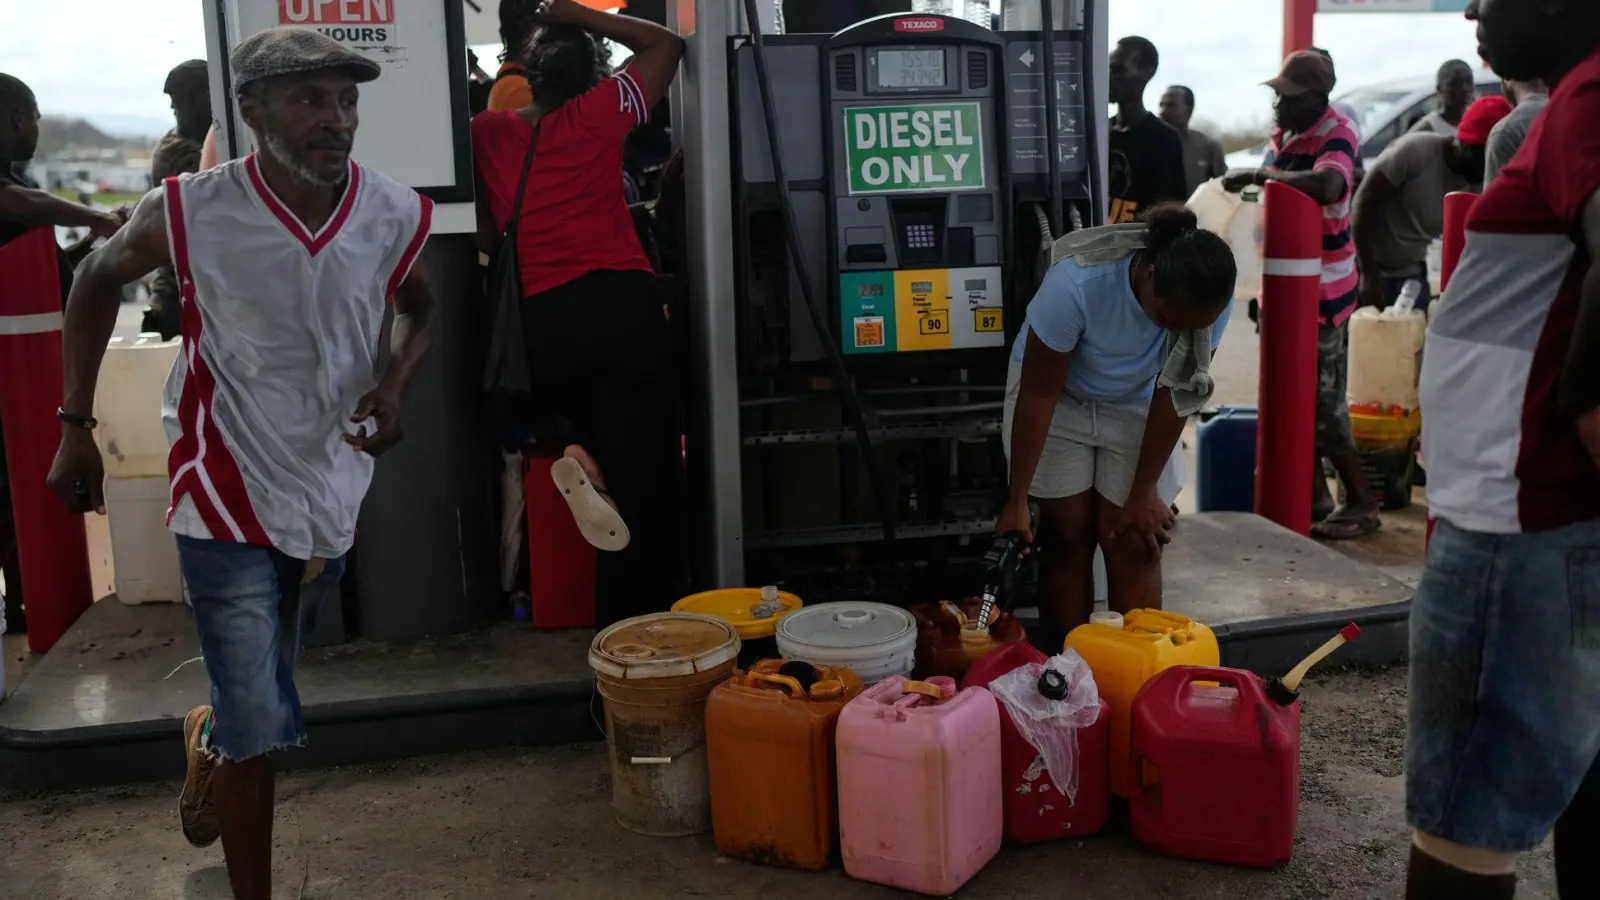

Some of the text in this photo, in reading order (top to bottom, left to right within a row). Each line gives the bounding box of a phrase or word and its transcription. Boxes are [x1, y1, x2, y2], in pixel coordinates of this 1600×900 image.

[901, 20, 937, 29] TEXACO
[855, 110, 973, 150] DIESEL
[861, 153, 970, 185] ONLY
[927, 319, 941, 330] 90
[982, 316, 996, 328] 87
